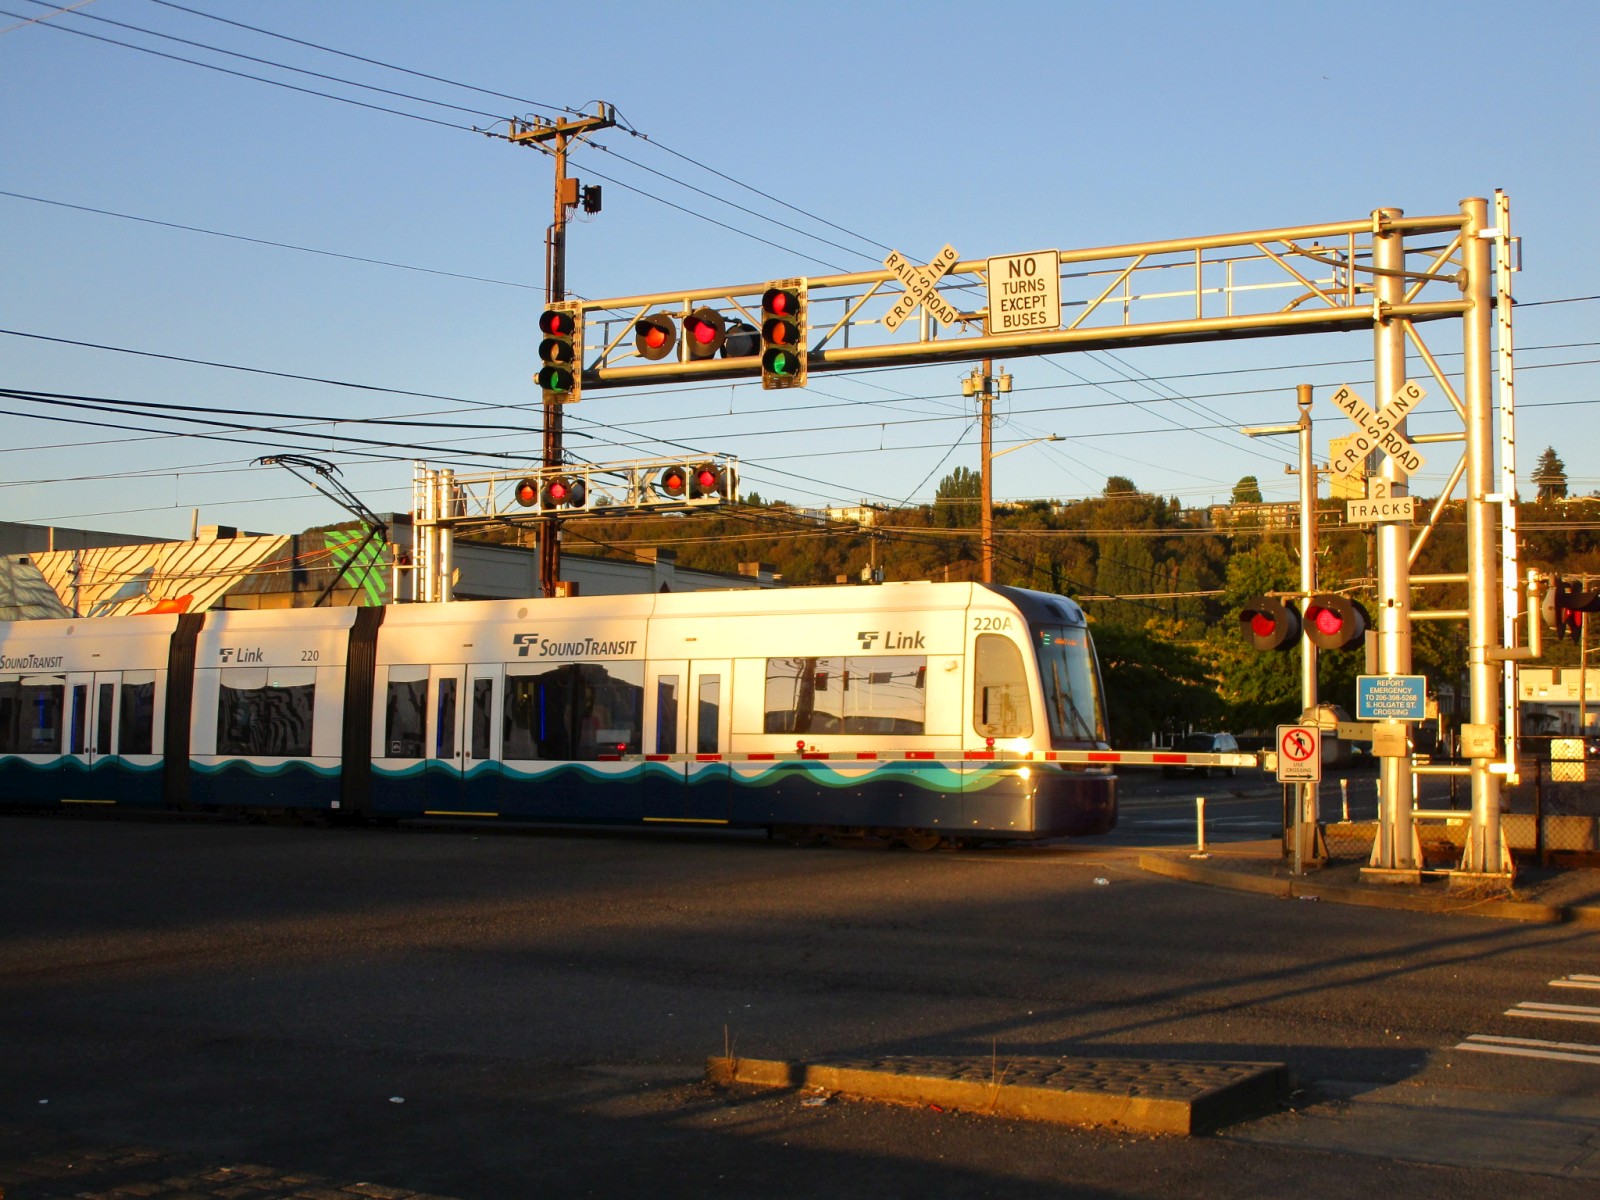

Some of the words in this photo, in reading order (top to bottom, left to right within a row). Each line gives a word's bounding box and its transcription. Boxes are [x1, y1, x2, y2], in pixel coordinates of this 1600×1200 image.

[1008, 257, 1037, 279] NO
[885, 248, 955, 328] CROSSING
[1002, 278, 1046, 296] TURNS
[1001, 294, 1048, 313] EXCEPT
[1003, 311, 1047, 329] BUSES
[1334, 385, 1420, 473] CROSSING
[1375, 483, 1386, 499] 2
[1350, 503, 1411, 517] TRACKS
[973, 617, 1013, 631] 220A
[884, 630, 926, 650] Link
[236, 647, 264, 663] Link
[300, 650, 320, 662] 220
